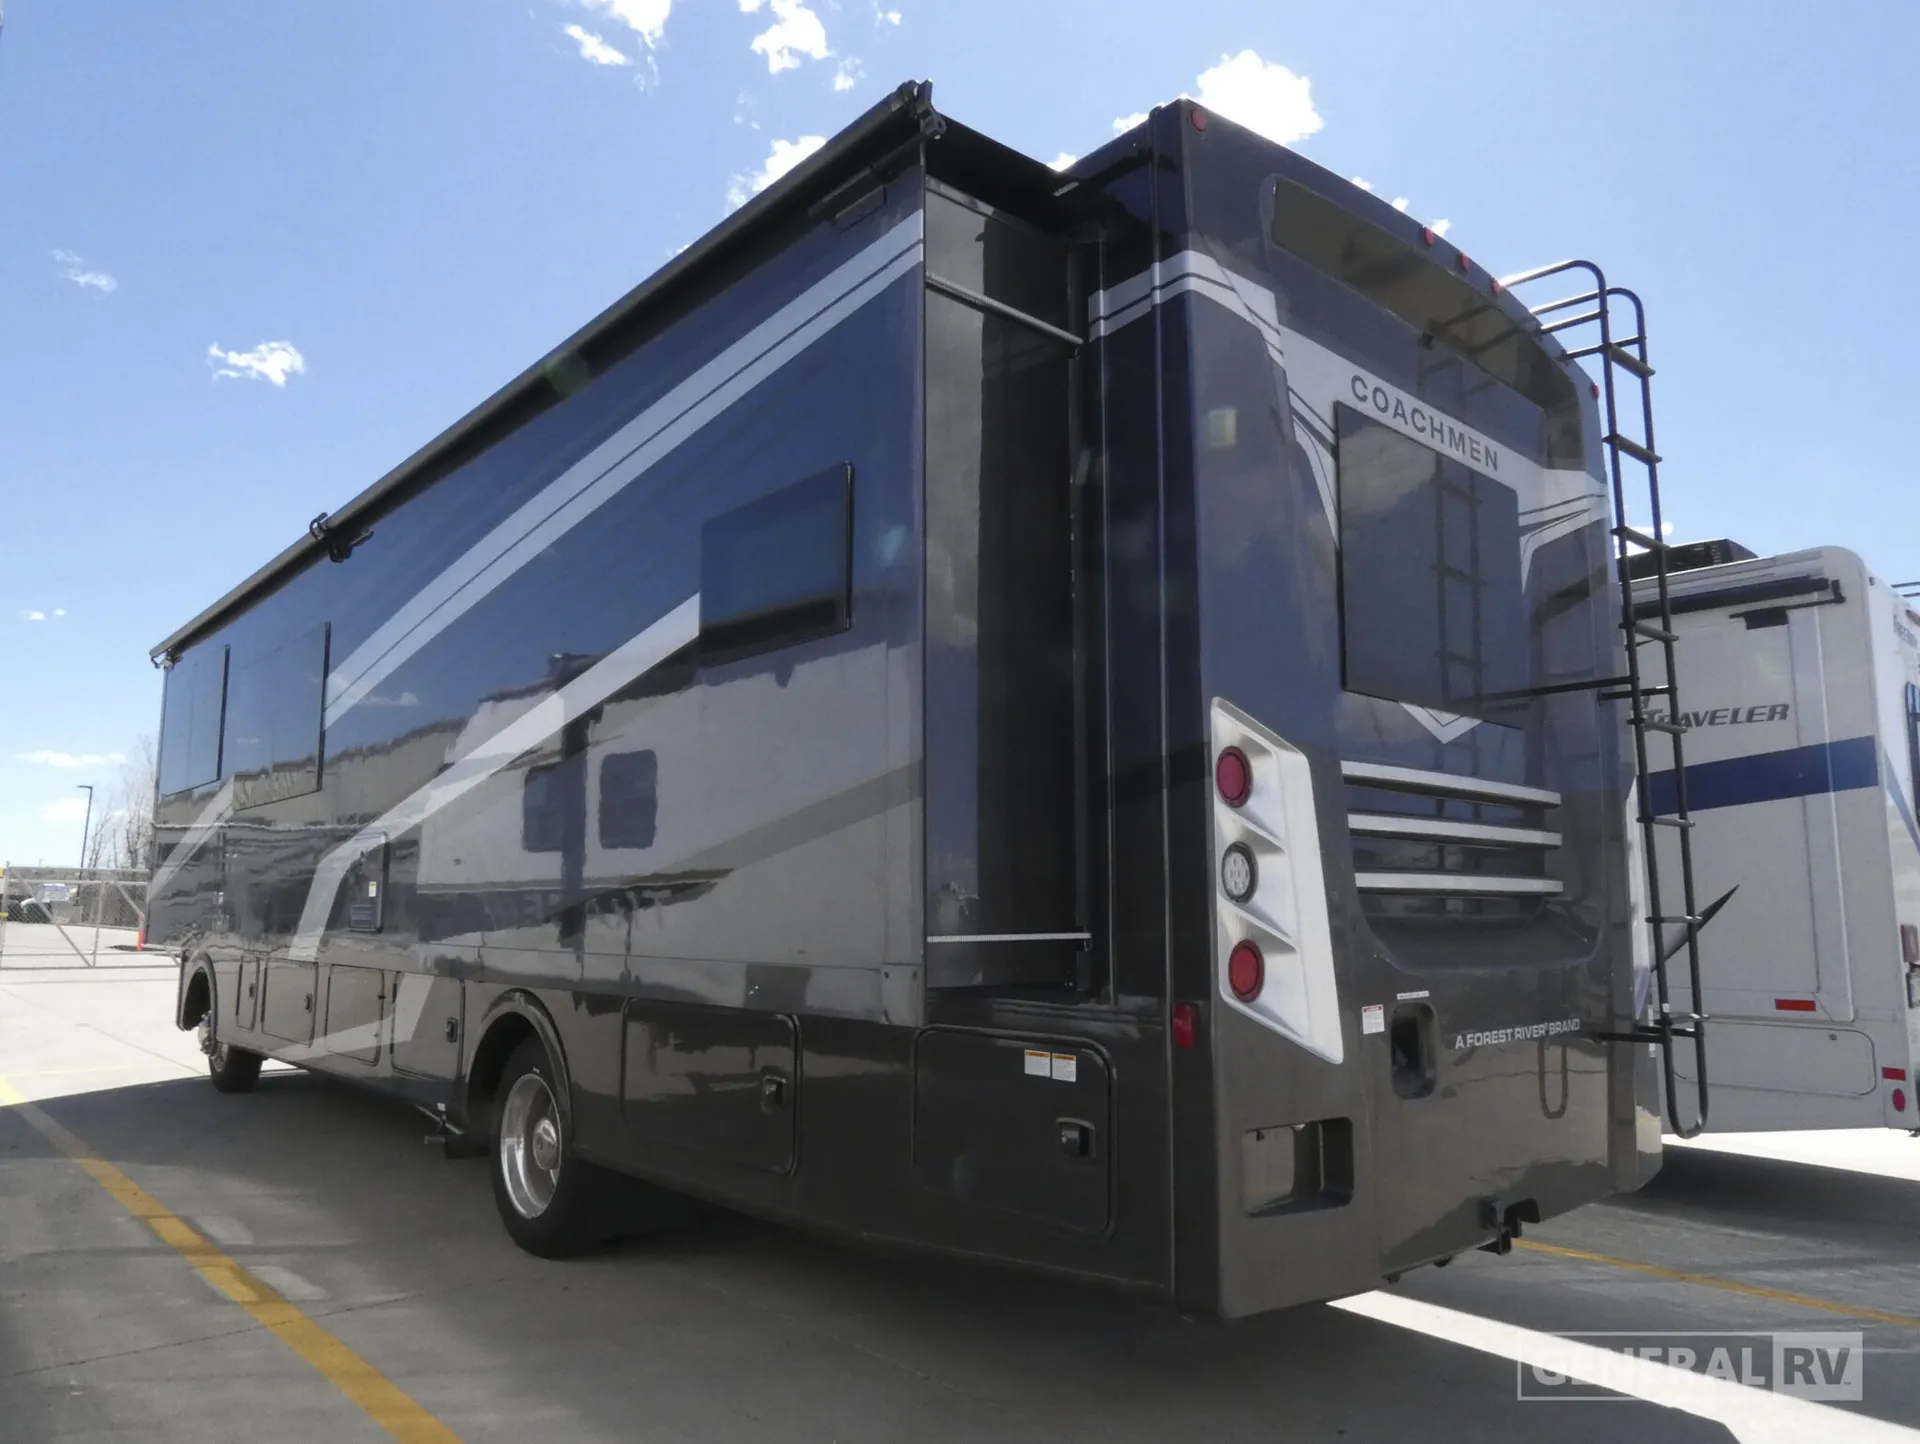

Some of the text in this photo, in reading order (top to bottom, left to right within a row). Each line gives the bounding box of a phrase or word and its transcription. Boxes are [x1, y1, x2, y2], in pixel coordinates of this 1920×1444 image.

[1351, 374, 1498, 472] COACHMEN
[1455, 1035, 1465, 1049] A
[1466, 1028, 1513, 1047] FOREST
[1549, 1018, 1580, 1035] BRAND
